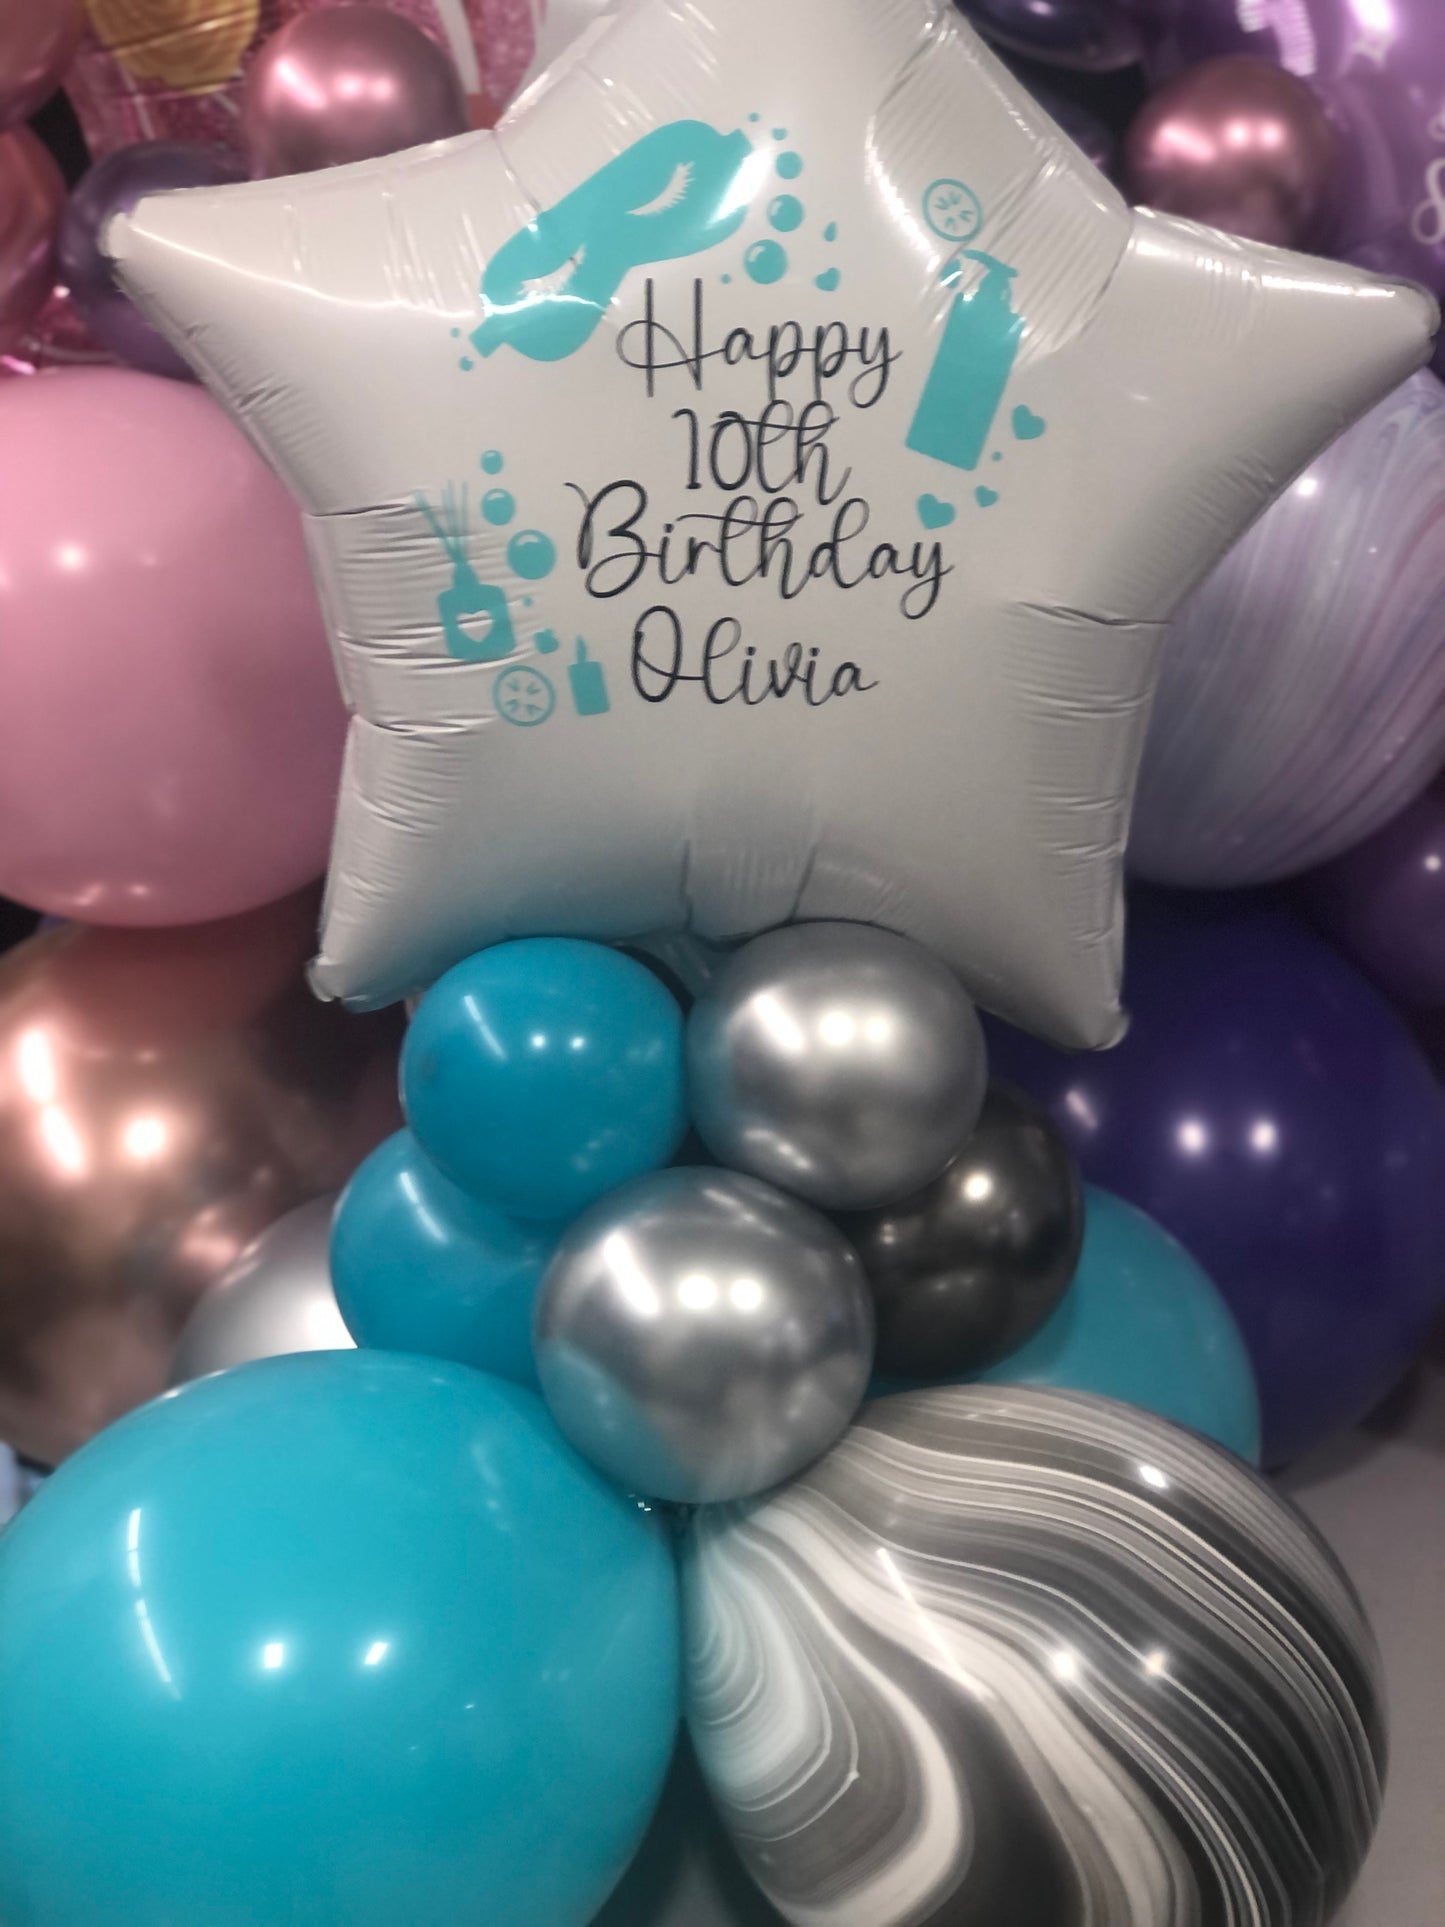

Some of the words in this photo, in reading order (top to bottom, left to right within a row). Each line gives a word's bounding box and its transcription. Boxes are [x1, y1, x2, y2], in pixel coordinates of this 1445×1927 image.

[615, 277, 904, 408] Happy
[671, 399, 852, 505] 10th
[563, 479, 955, 620] Birthday
[631, 604, 880, 706] Olivia
